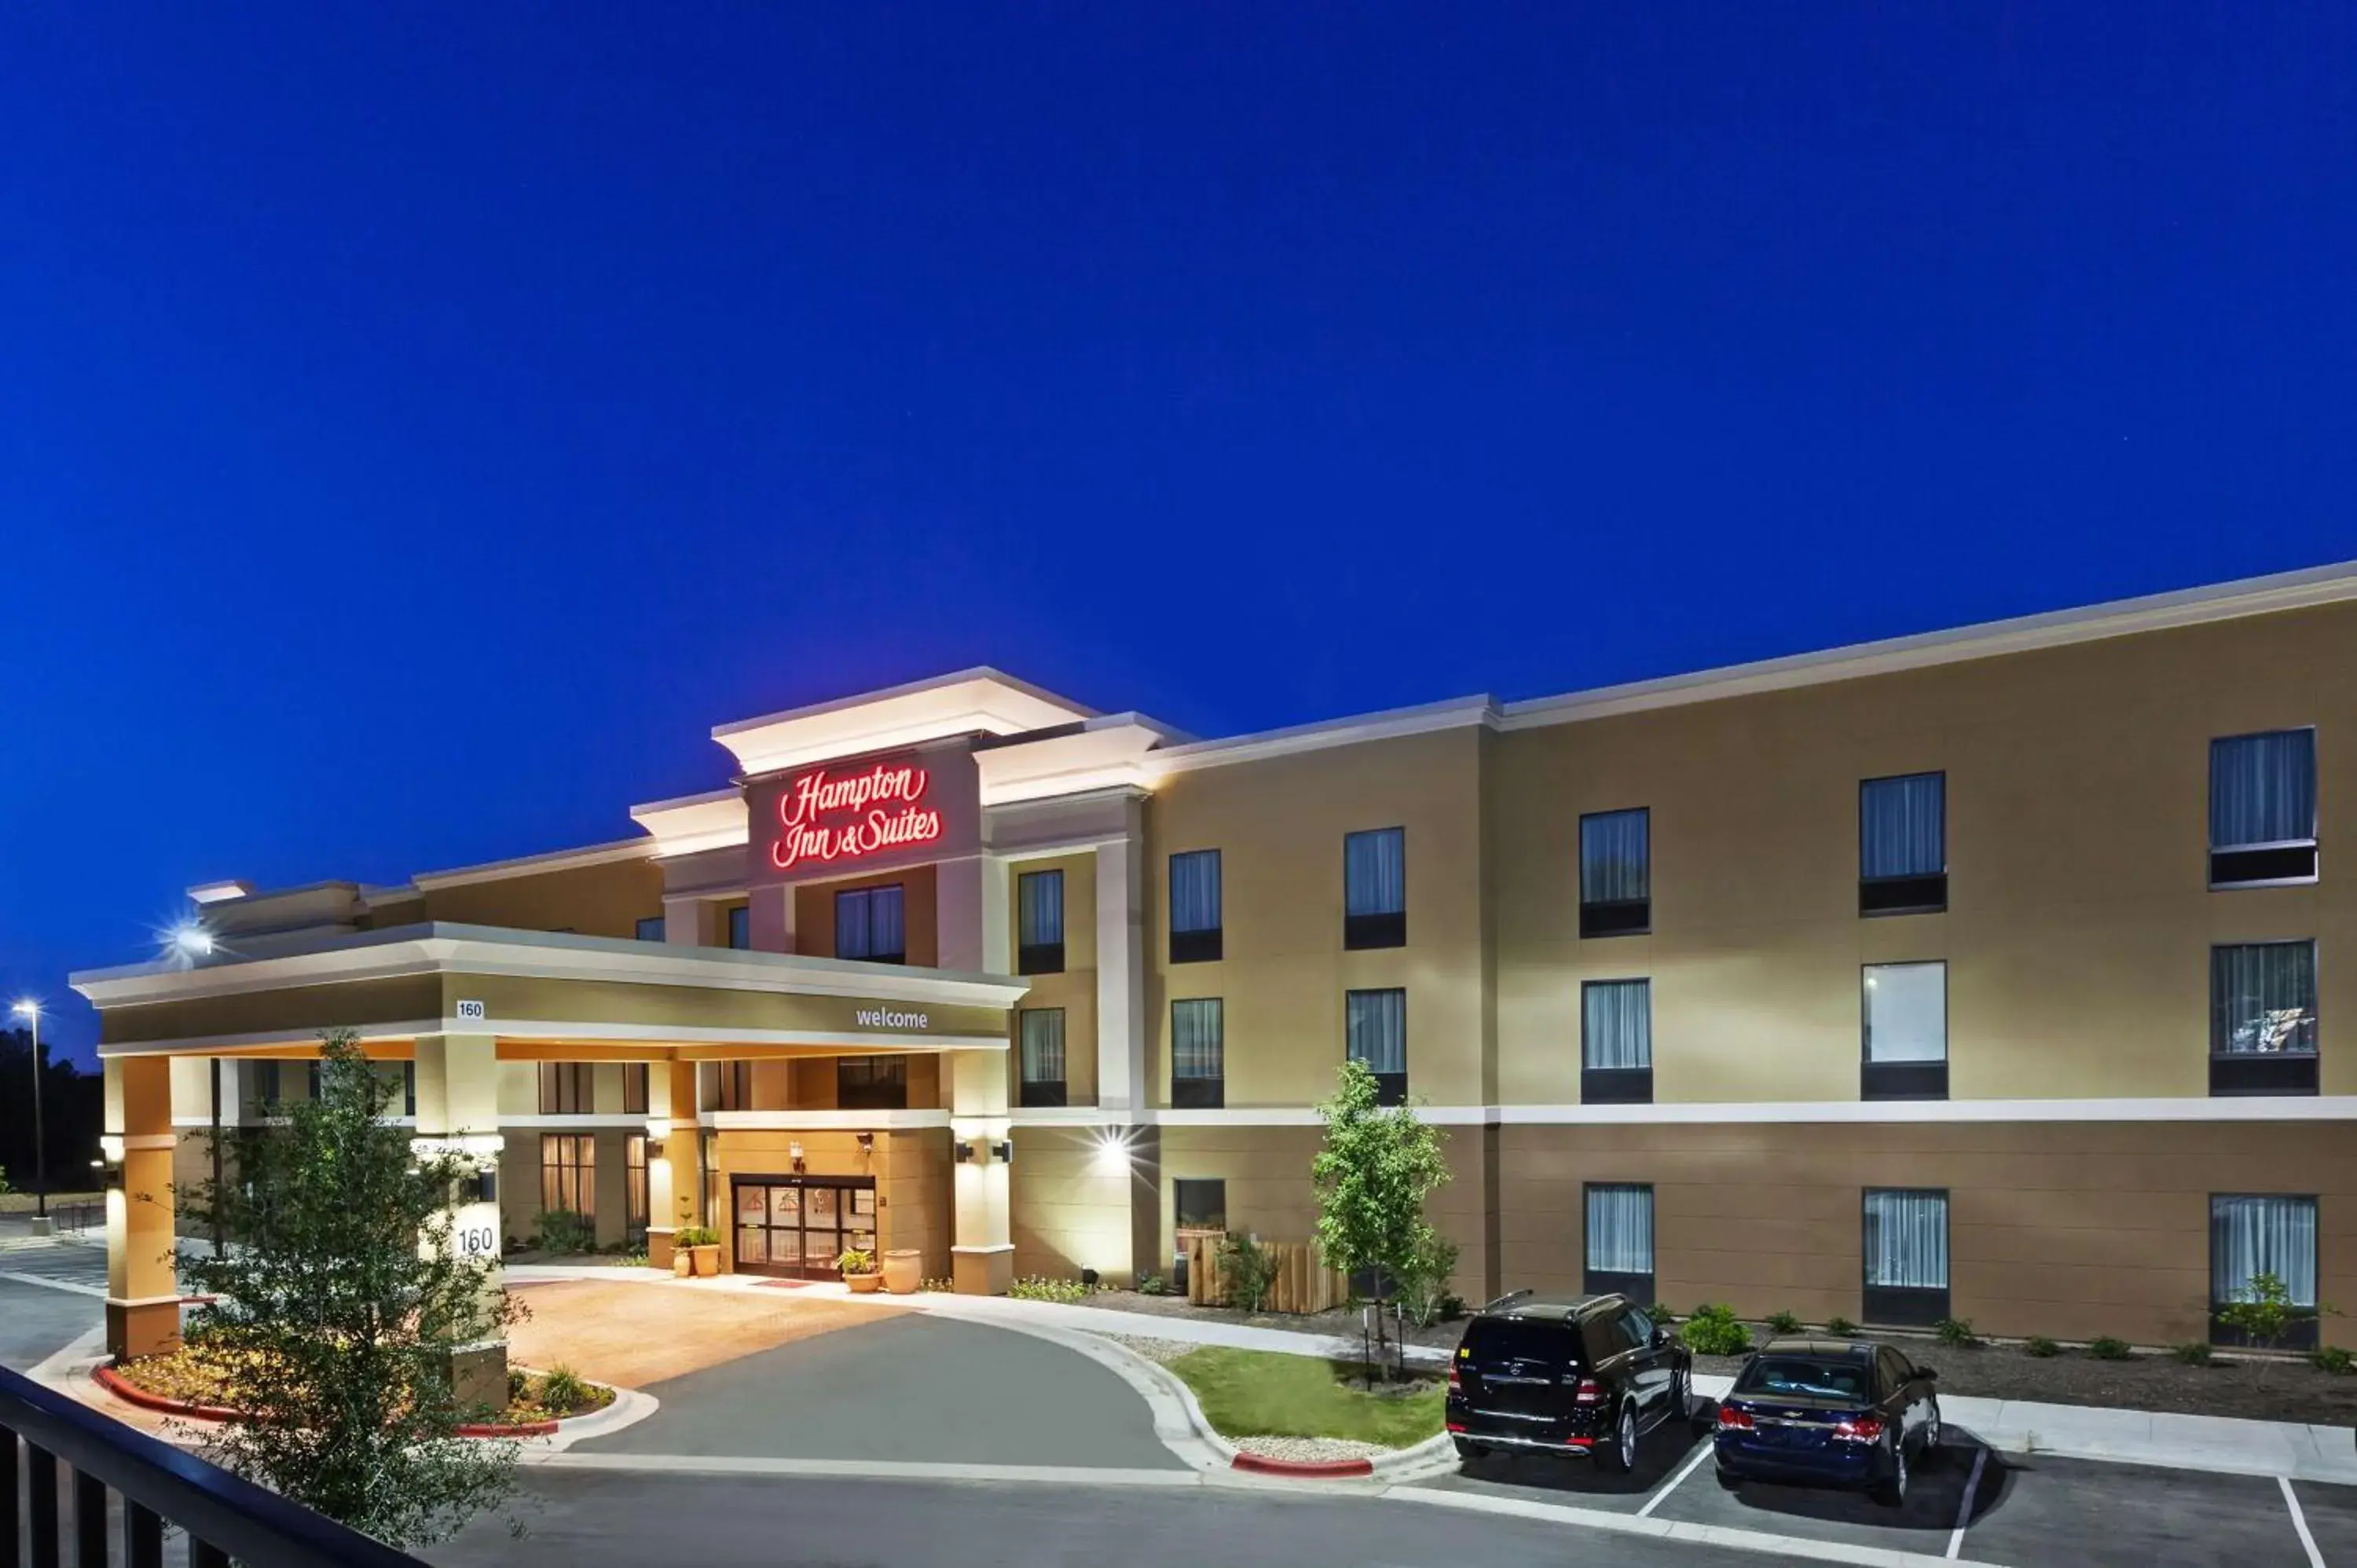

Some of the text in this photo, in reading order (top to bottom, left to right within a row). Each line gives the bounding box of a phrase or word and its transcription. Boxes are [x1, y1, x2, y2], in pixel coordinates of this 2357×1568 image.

[780, 765, 925, 826] Hampton
[772, 806, 939, 868] Inn & Suites
[460, 1002, 482, 1017] 160
[856, 1006, 928, 1028] welcome
[459, 1227, 493, 1251] 160
